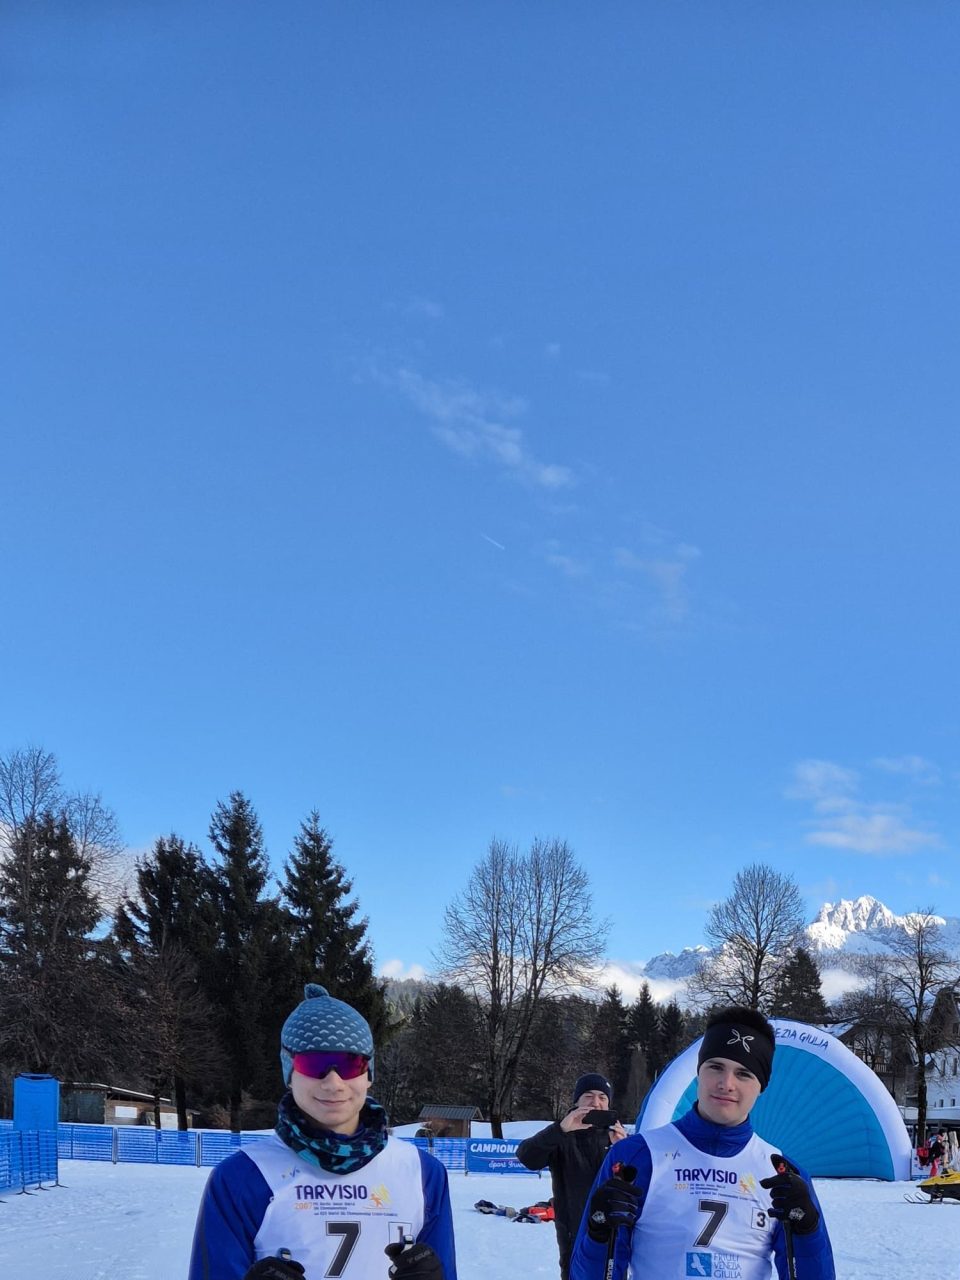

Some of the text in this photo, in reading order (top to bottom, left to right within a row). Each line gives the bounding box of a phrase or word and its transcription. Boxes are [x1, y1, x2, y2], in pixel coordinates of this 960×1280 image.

[799, 1032, 829, 1050] GIULIA
[674, 1168, 738, 1185] TARVISIO
[294, 1184, 368, 1200] TARVISIO
[693, 1199, 730, 1247] 7
[757, 1212, 766, 1228] 3
[324, 1221, 361, 1278] 7
[714, 1269, 742, 1279] GIULIA
